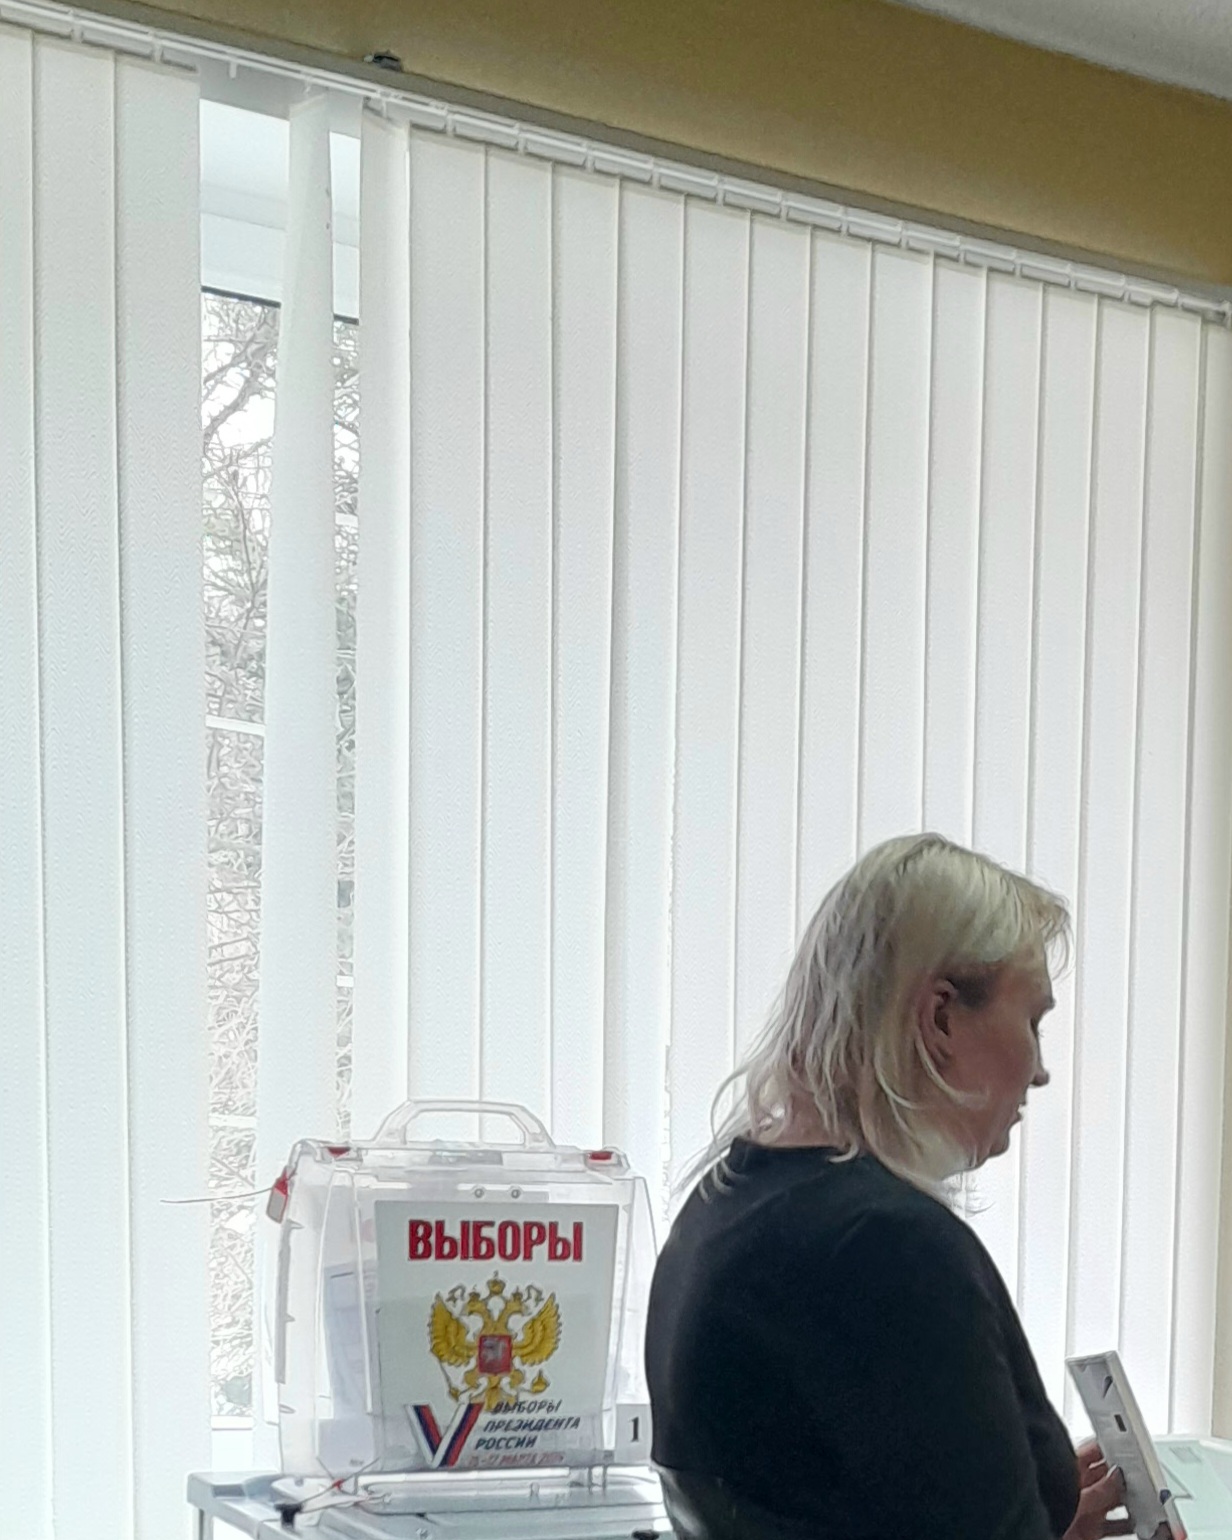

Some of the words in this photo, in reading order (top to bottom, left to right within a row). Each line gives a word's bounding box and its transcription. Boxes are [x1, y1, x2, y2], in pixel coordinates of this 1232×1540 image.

[407, 1218, 584, 1263] ВЫБОРЫ
[491, 1398, 564, 1415] ВЫБОРЫ
[482, 1416, 582, 1433] ПРЕЗИДЕНТА
[627, 1415, 640, 1443] 1
[473, 1434, 540, 1451] РОССИИ
